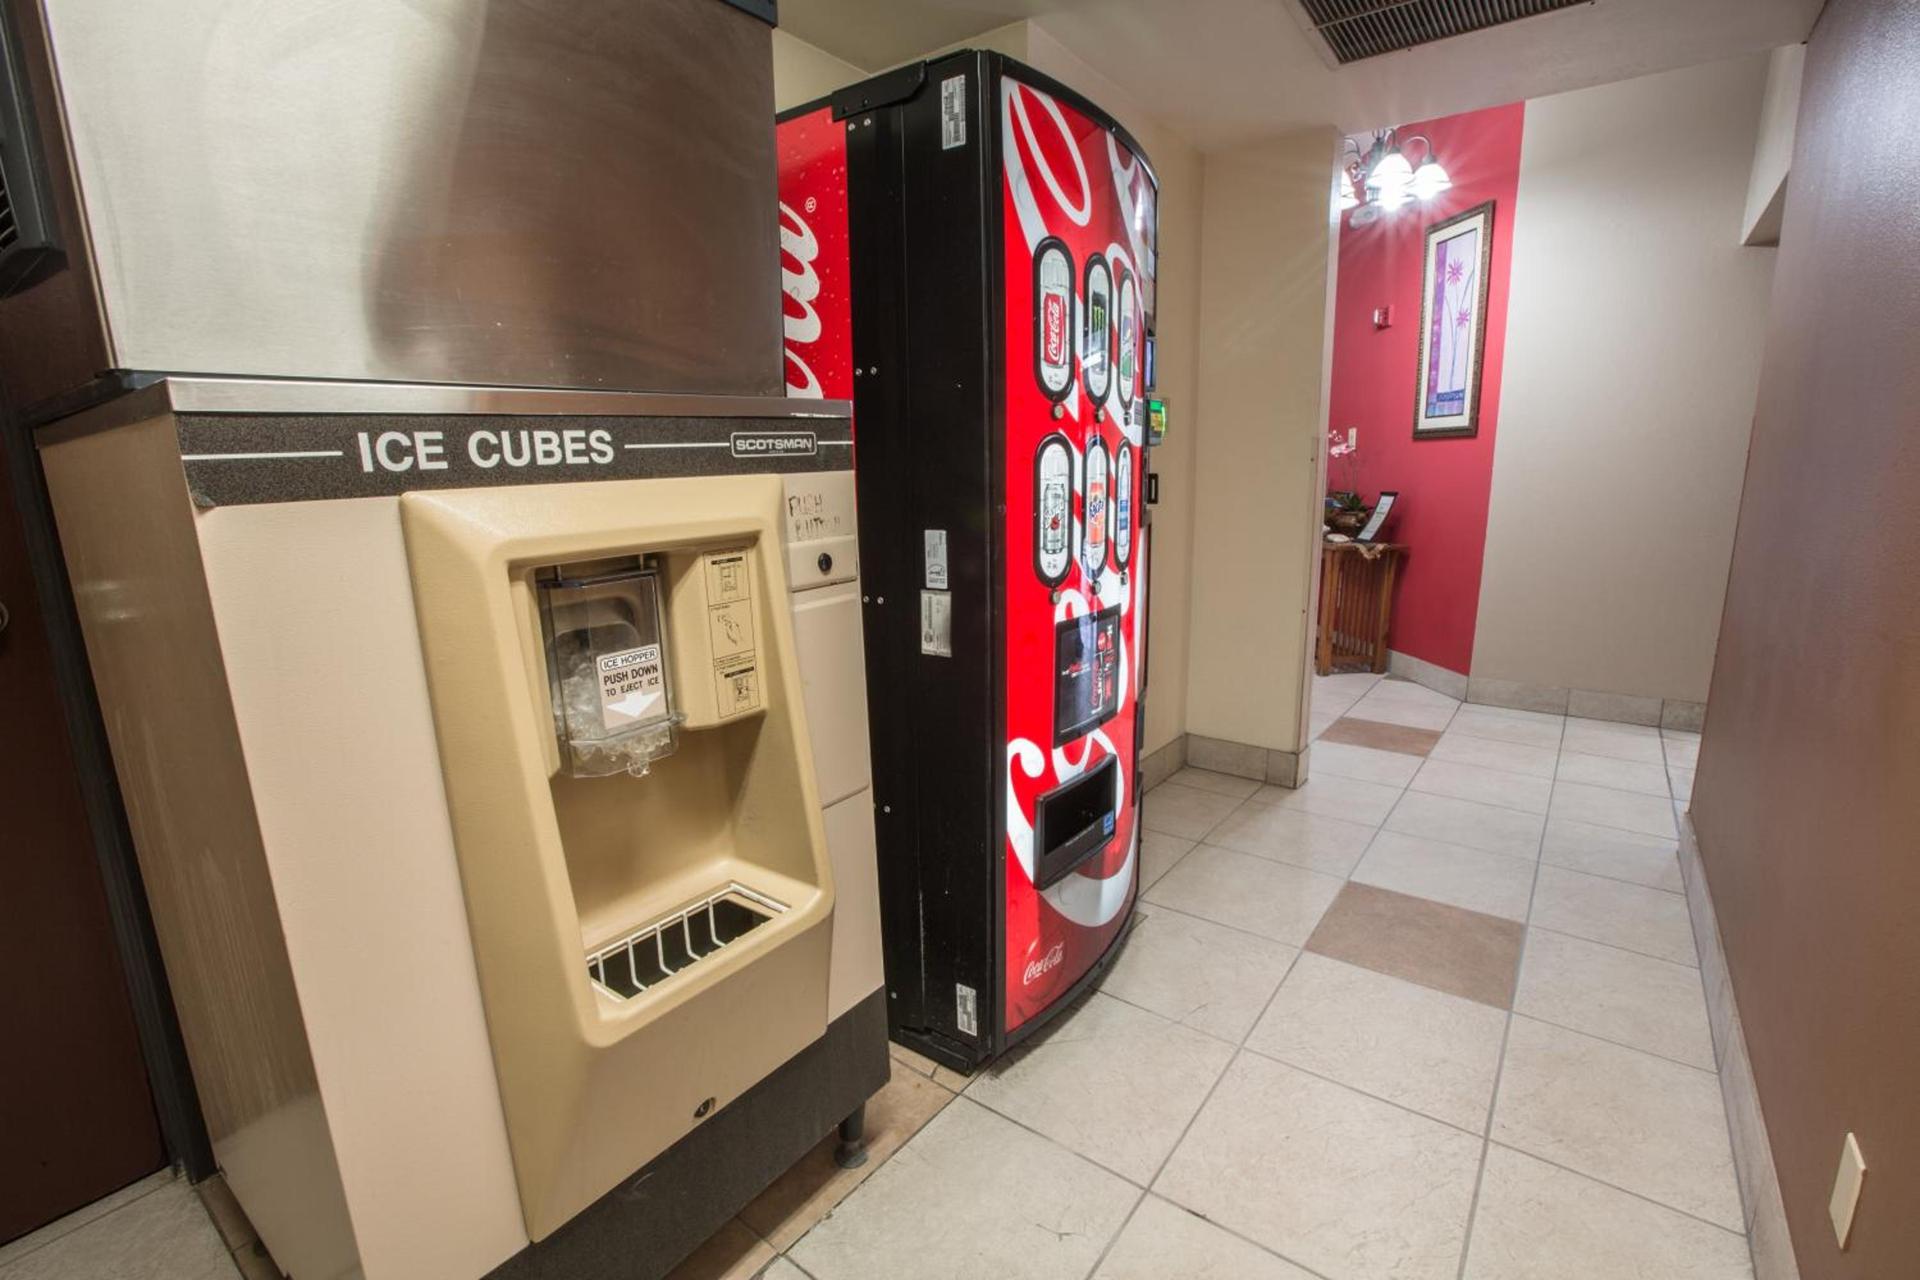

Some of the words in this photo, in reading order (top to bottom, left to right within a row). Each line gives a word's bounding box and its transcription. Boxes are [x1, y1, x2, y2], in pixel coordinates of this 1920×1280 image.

[357, 431, 449, 473] ICE
[467, 429, 615, 469] CUBES
[735, 438, 812, 451] SCOTSMAN
[604, 658, 618, 669] ICE
[621, 650, 656, 665] HOPPER
[603, 671, 628, 686] PUSH
[631, 664, 658, 679] DOWN
[605, 688, 616, 697] TO
[620, 681, 643, 694] EJECT
[648, 676, 659, 687] ICE
